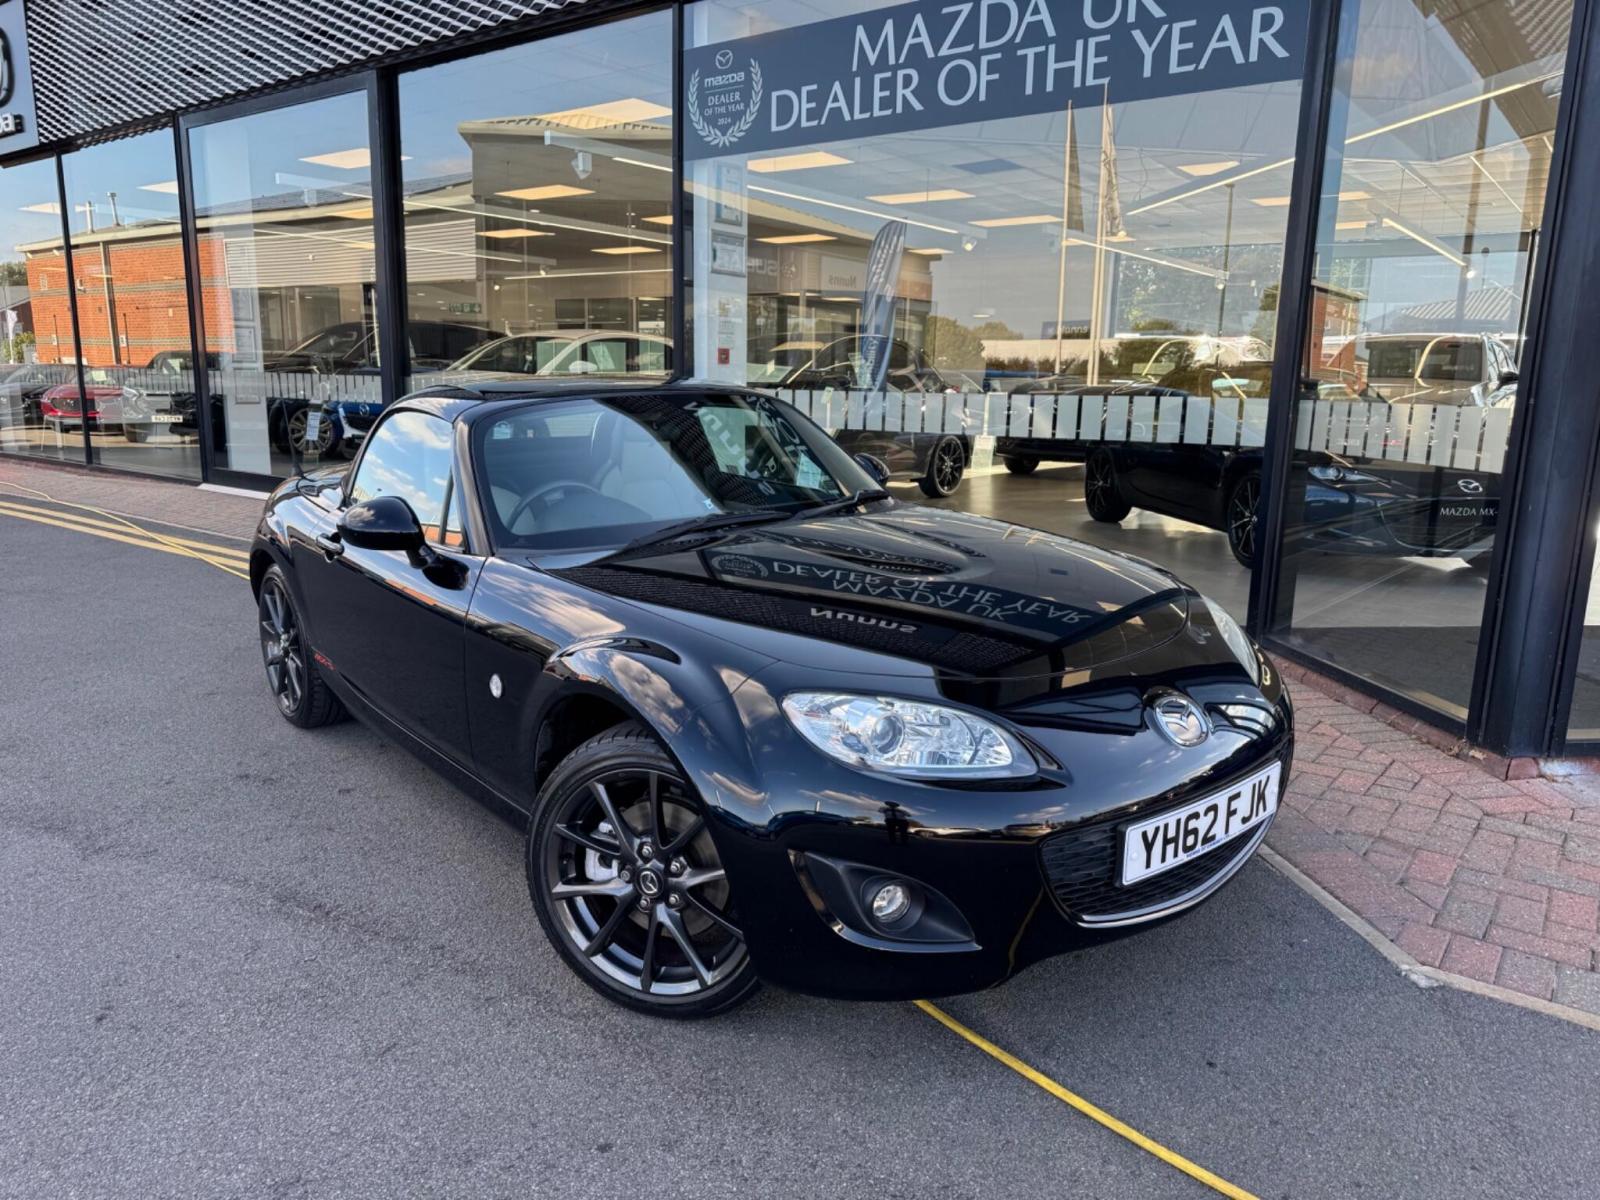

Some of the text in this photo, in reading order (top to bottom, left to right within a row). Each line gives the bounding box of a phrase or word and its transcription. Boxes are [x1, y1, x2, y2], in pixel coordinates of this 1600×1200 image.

[852, 0, 1056, 72] MAZDA
[771, 6, 1290, 132] DEALER OF THE YEAR
[704, 102, 745, 116] OF THE YEAR
[708, 91, 741, 106] DEALER
[1440, 507, 1476, 516] MAZDA
[1141, 775, 1270, 869] YH62 FJK
